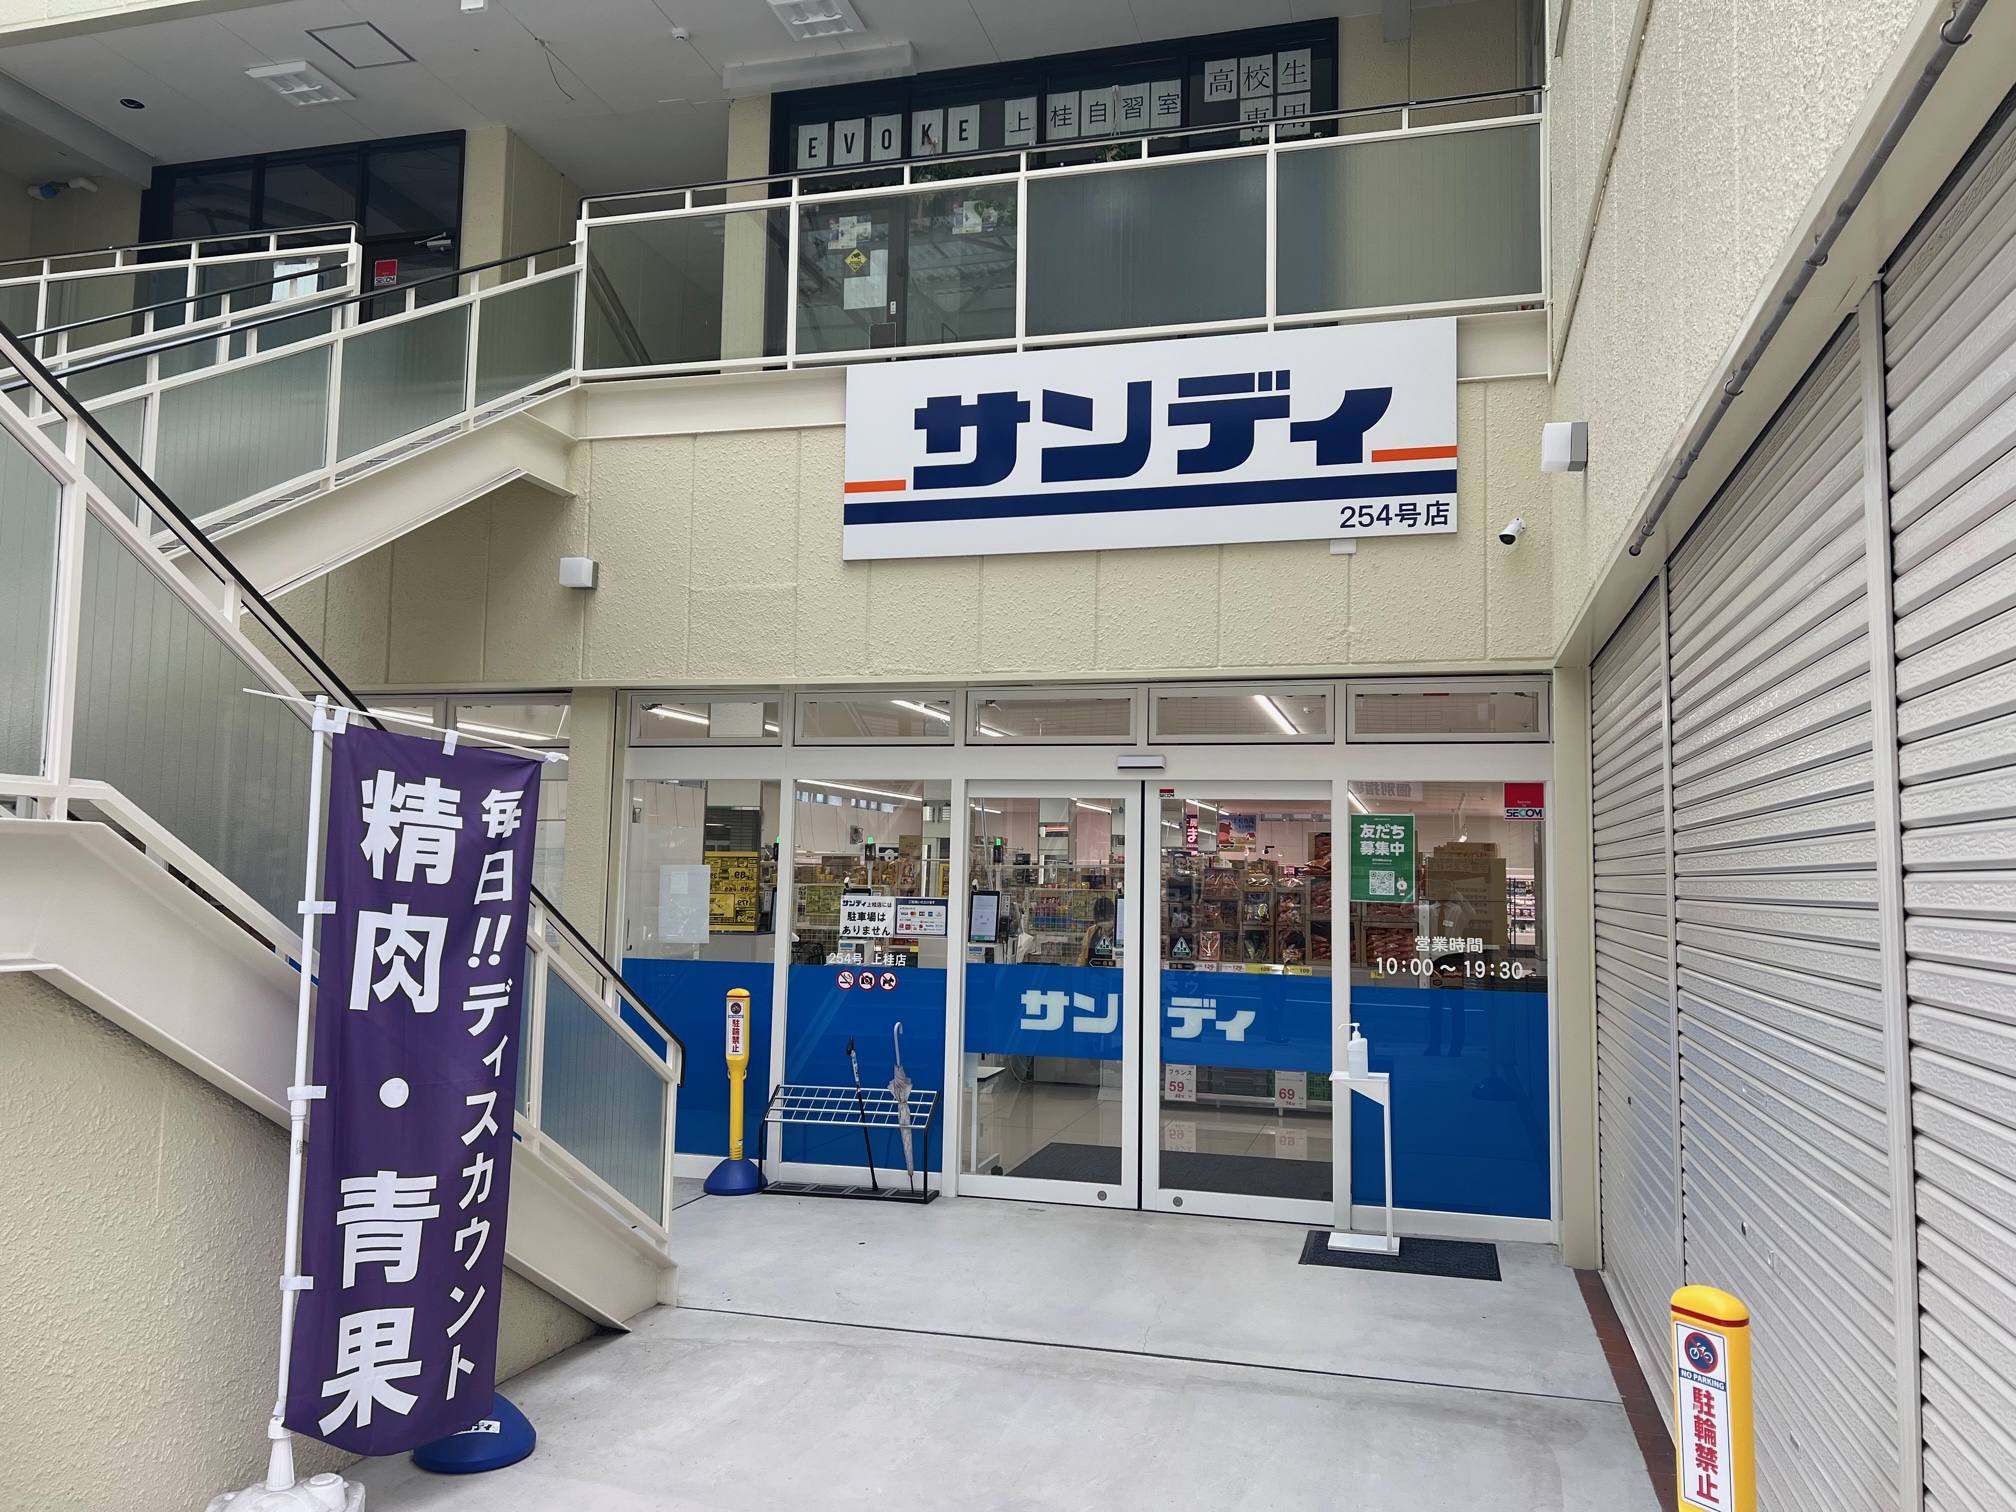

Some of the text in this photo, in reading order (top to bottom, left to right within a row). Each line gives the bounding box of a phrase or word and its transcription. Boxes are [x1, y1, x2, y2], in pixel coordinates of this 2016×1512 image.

[1208, 60, 1308, 96] 高校生
[808, 93, 1180, 159] EVOKE 上桂自習室
[913, 370, 1393, 490] サンディ
[1340, 500, 1450, 529] 254号店
[1506, 808, 1543, 818] SECOM
[1360, 823, 1405, 839] 友だち
[1360, 841, 1405, 857] 募集中
[847, 911, 886, 922] 駐車場は
[842, 925, 891, 936] ありません
[1415, 936, 1483, 953] 営業時間
[829, 952, 907, 967] 254号 上桂店
[1169, 1069, 1193, 1077] フランス
[1169, 1081, 1185, 1092] 59
[1279, 1088, 1295, 1100] 69
[317, 769, 463, 1437] 精肉・青果
[1680, 1369, 1725, 1391] NO PARKING
[1692, 1386, 1720, 1504] 駐輪禁止
